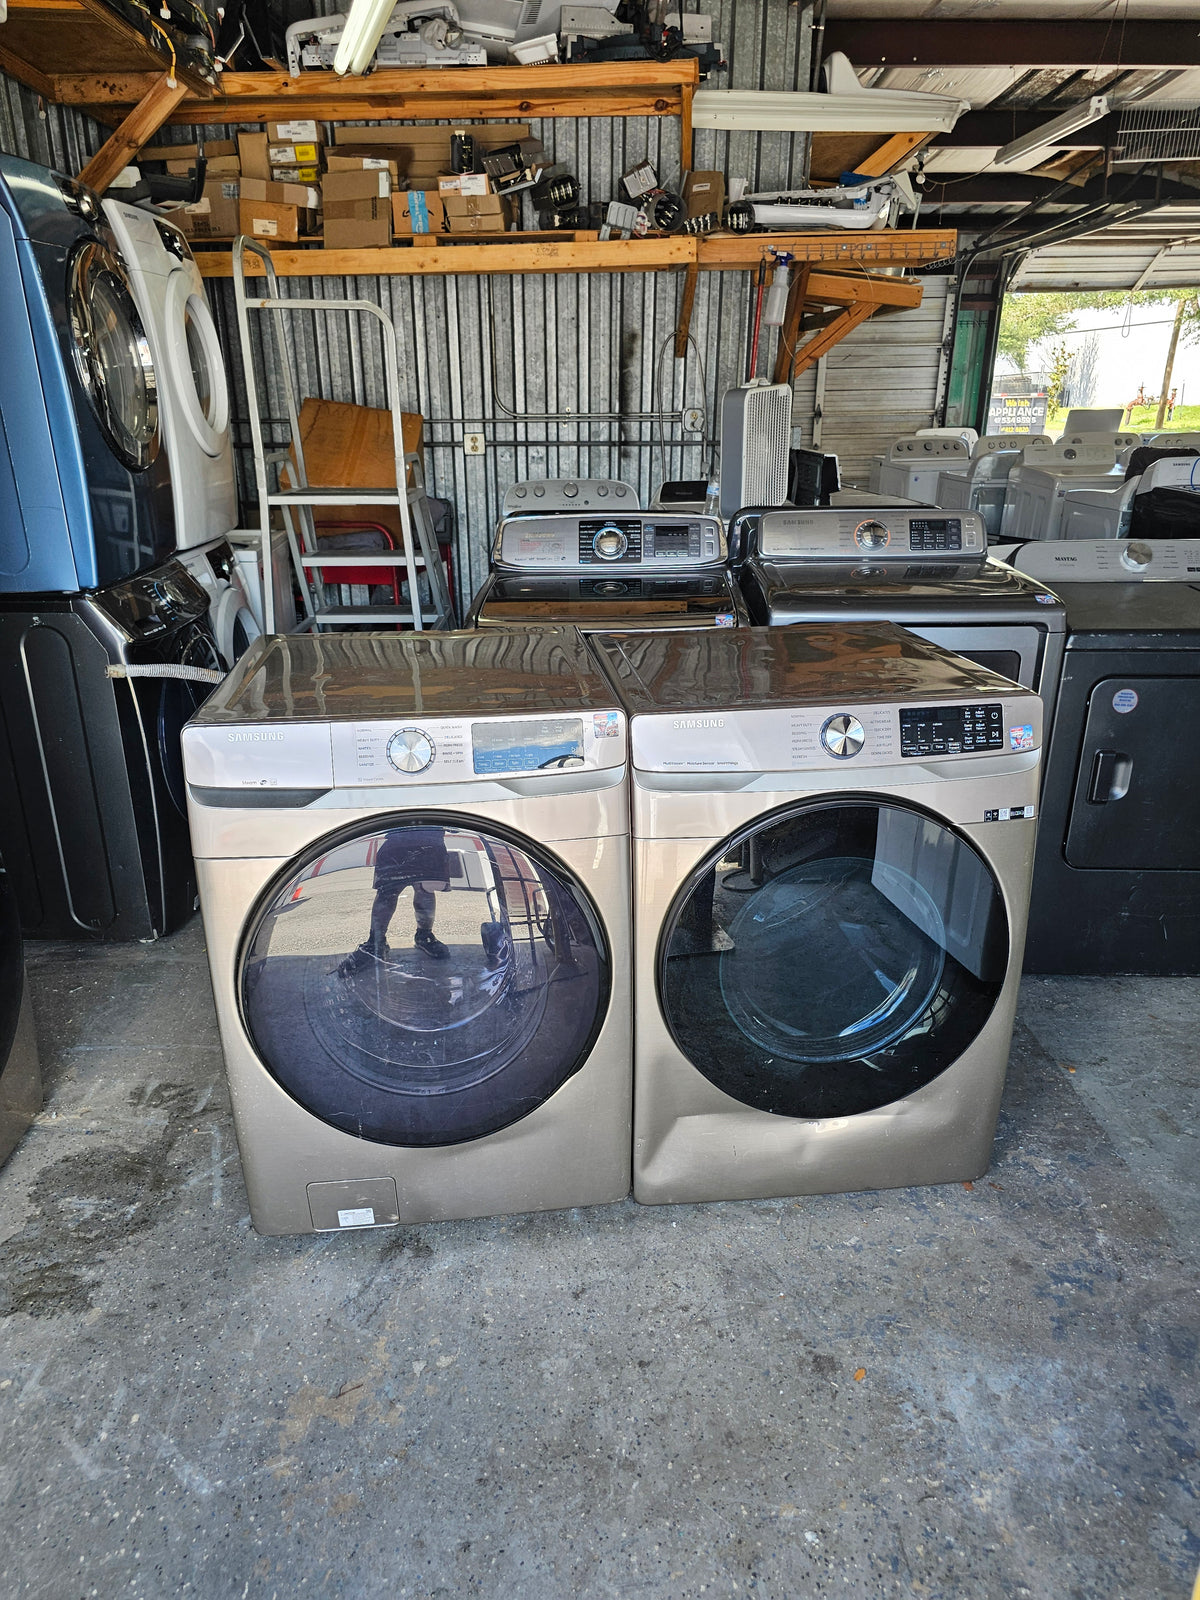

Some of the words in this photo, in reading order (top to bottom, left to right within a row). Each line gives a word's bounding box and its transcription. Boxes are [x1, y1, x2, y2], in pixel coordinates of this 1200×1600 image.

[988, 407, 1044, 416] APPLIANCE
[673, 718, 725, 729] SAMSUNG
[227, 732, 285, 742] SAMSUNG
